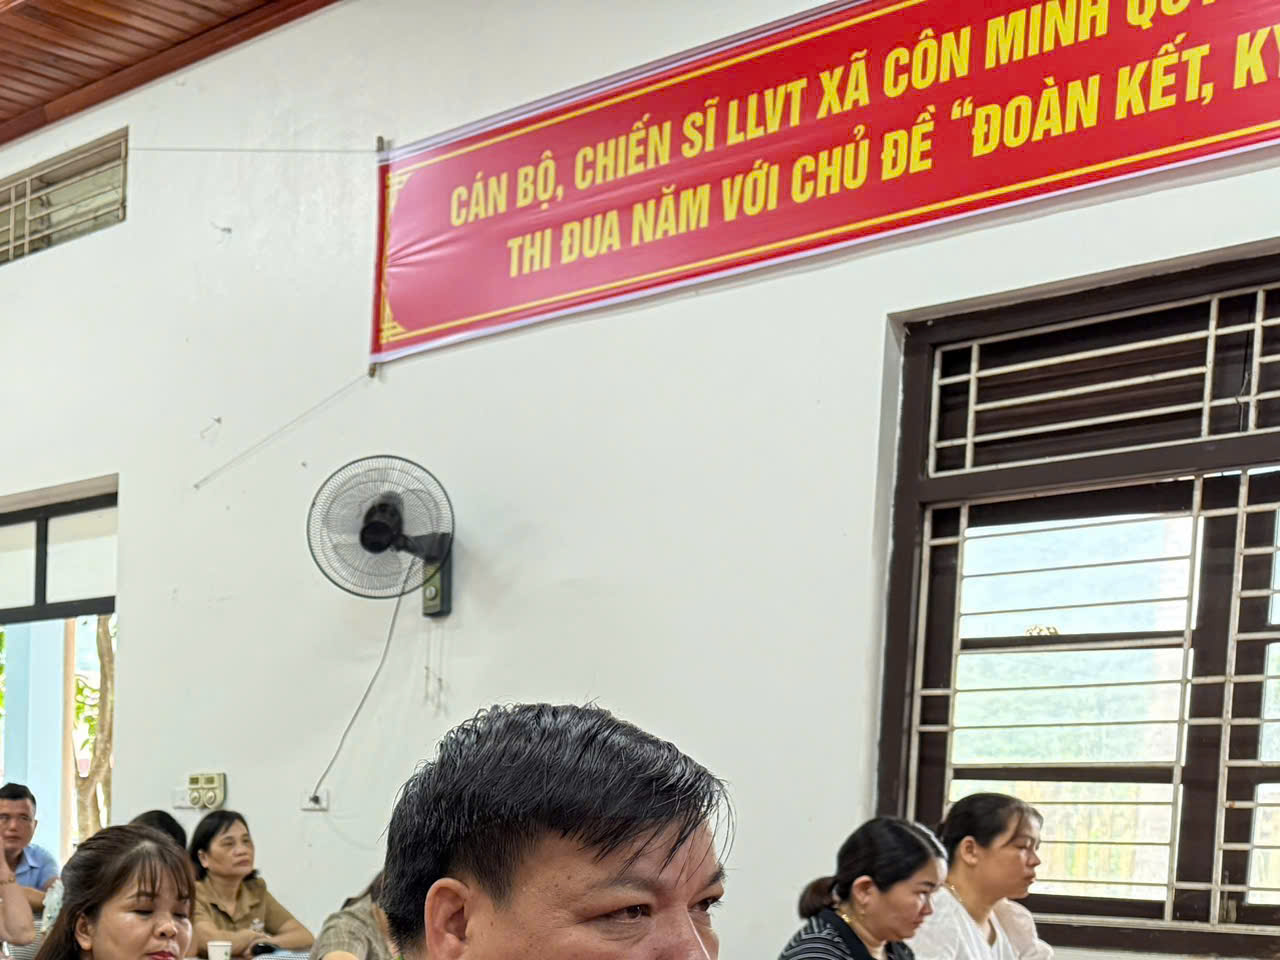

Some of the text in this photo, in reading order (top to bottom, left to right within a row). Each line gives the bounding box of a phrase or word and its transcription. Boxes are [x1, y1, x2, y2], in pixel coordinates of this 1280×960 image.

[450, 171, 509, 227] CÁN
[516, 150, 564, 210] BỘ,
[575, 113, 672, 190] CHIẾN
[681, 96, 719, 158] SĨ
[726, 78, 808, 146] LLVT
[816, 49, 870, 120] XÃ
[883, 25, 971, 98] CÔN
[984, 0, 1109, 70] MINH
[507, 229, 552, 278] THI
[560, 209, 621, 265] ĐUA
[631, 183, 711, 246] NĂM
[721, 159, 780, 223] VỚI
[790, 124, 870, 204] CHỦ
[880, 104, 935, 181] ĐỀ
[1114, 32, 1214, 120] KẾT,
[1232, 24, 1280, 90] K
